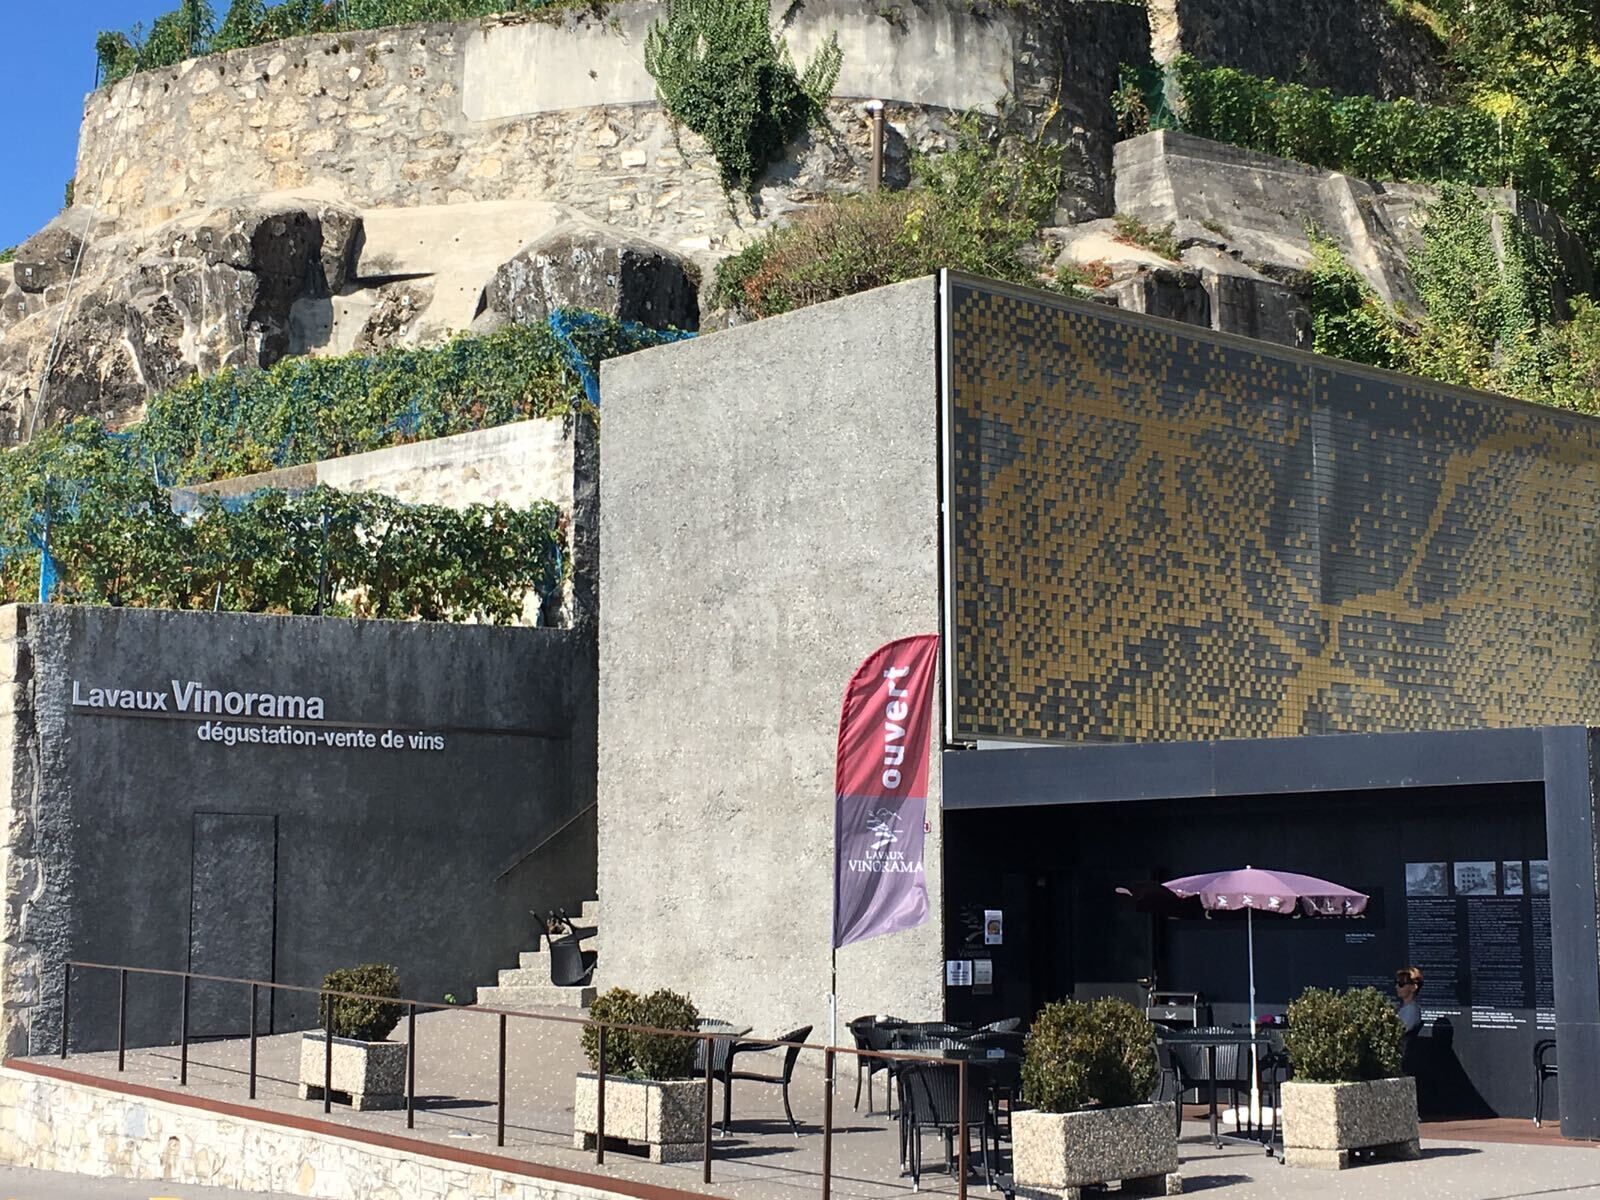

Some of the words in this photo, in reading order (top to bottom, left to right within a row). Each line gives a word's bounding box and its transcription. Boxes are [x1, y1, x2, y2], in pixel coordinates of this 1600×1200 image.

[72, 680, 167, 711] Lavaux
[172, 679, 325, 719] Vinorama
[197, 721, 376, 747] dégustation-vente
[381, 733, 404, 749] de
[408, 735, 445, 750] vins
[882, 665, 909, 789] ouvert
[849, 860, 924, 872] VINORAMA
[866, 851, 904, 861] LAVAUX
